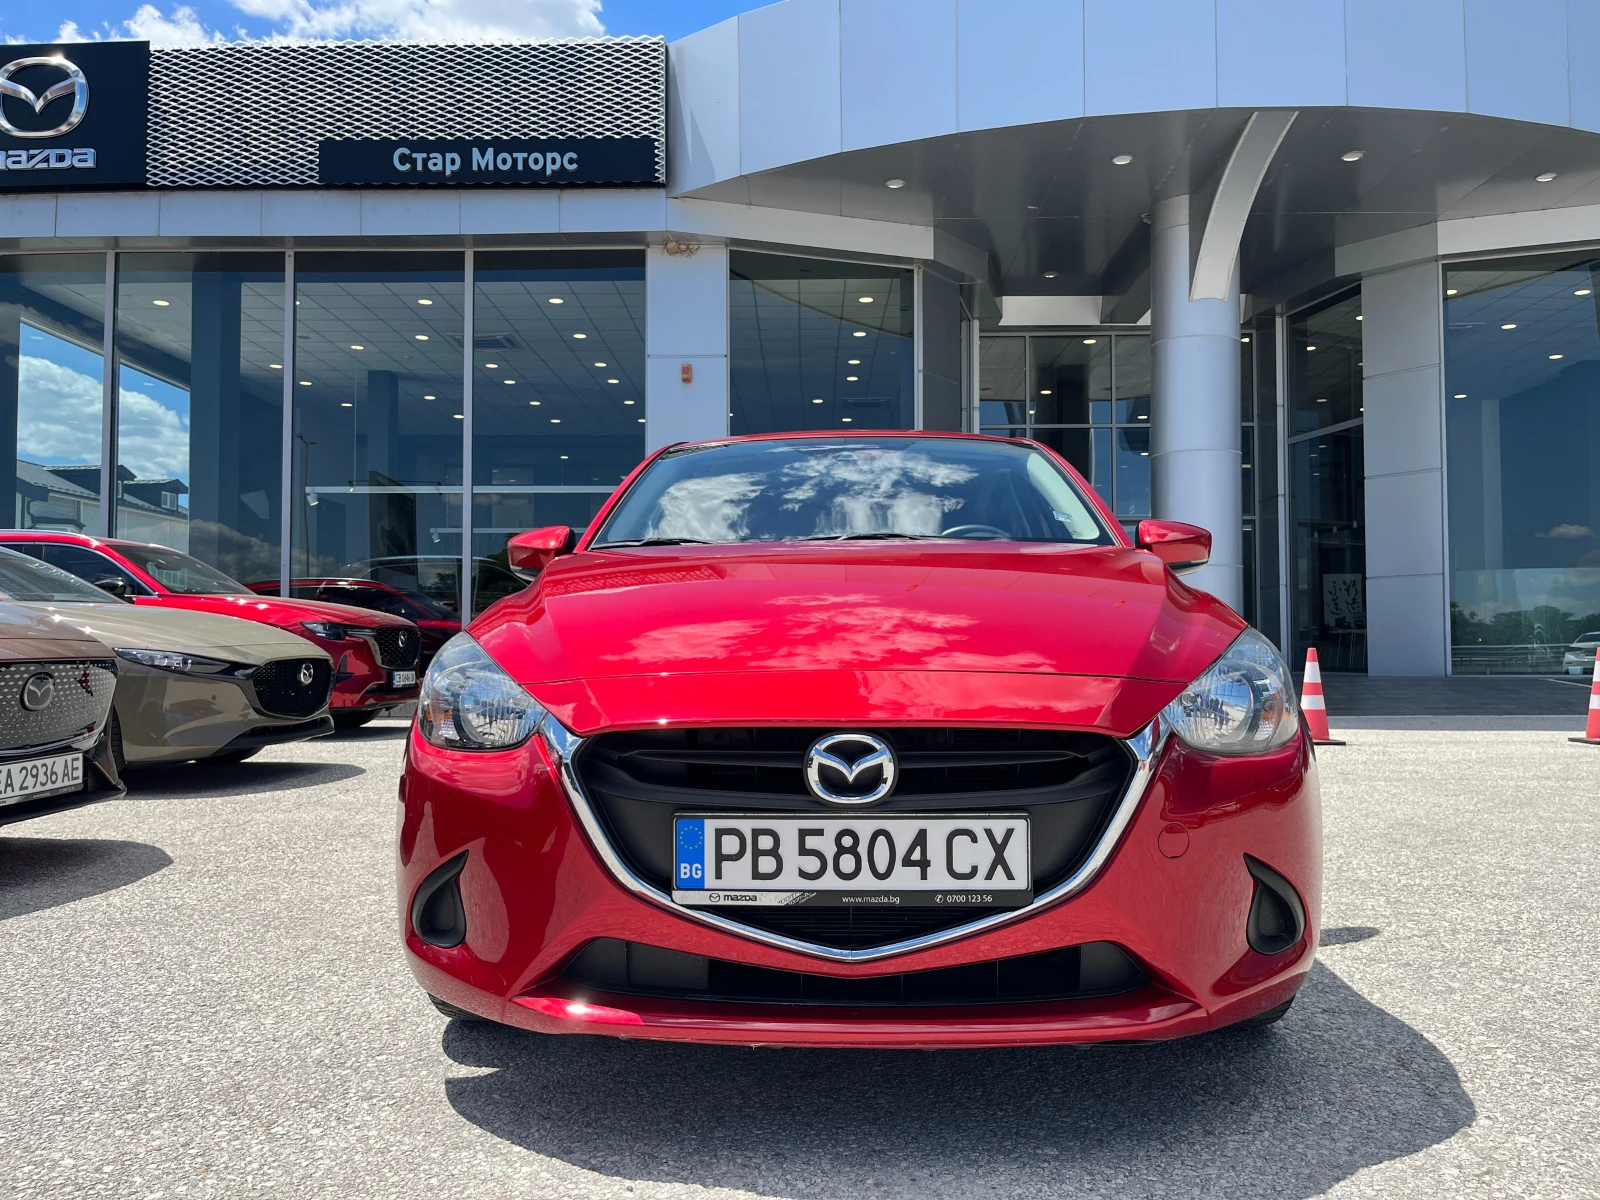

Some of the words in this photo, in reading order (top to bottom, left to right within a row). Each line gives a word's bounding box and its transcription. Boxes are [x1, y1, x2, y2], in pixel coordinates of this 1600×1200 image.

[392, 147, 462, 177] Стар
[471, 147, 579, 177] Моторс
[0, 767, 15, 795] A
[19, 760, 59, 792] 2936
[61, 757, 80, 784] AE
[714, 827, 784, 881] PB
[797, 827, 932, 881] 5804
[945, 827, 1016, 881] CX
[680, 863, 702, 880] BG
[841, 894, 900, 905] www.mazda.bg
[946, 894, 966, 904] 0700
[968, 894, 982, 903] 123
[982, 894, 993, 903] 56
